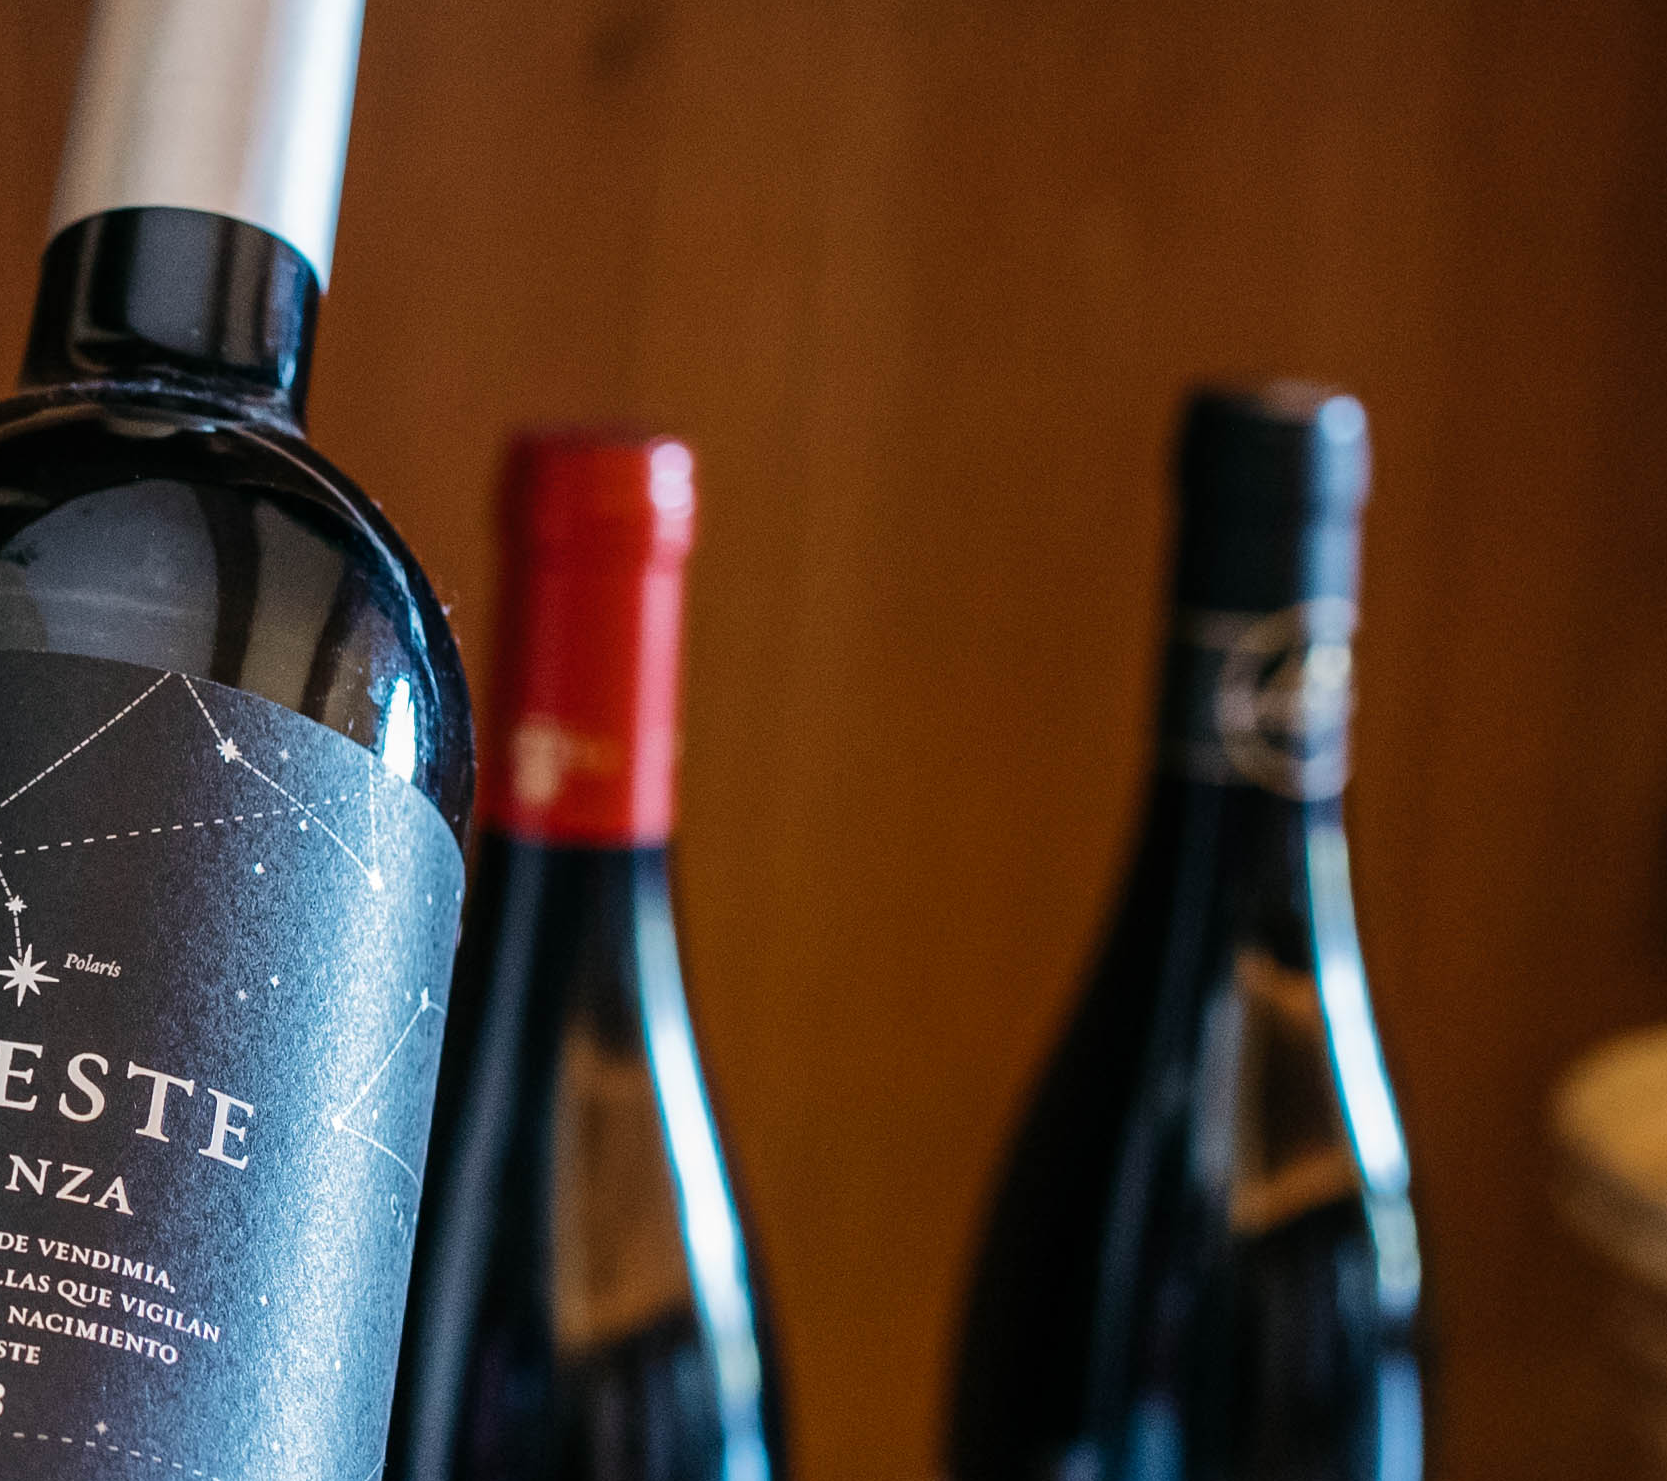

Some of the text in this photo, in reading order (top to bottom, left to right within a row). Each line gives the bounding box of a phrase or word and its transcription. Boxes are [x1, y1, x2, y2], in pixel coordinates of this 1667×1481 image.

[63, 952, 122, 978] Polaris
[37, 1237, 176, 1293] VENDIMIA,
[7, 1305, 178, 1365] NACIMIENTO
[57, 1278, 113, 1308] QUE
[119, 1292, 221, 1344] VIGILAN
